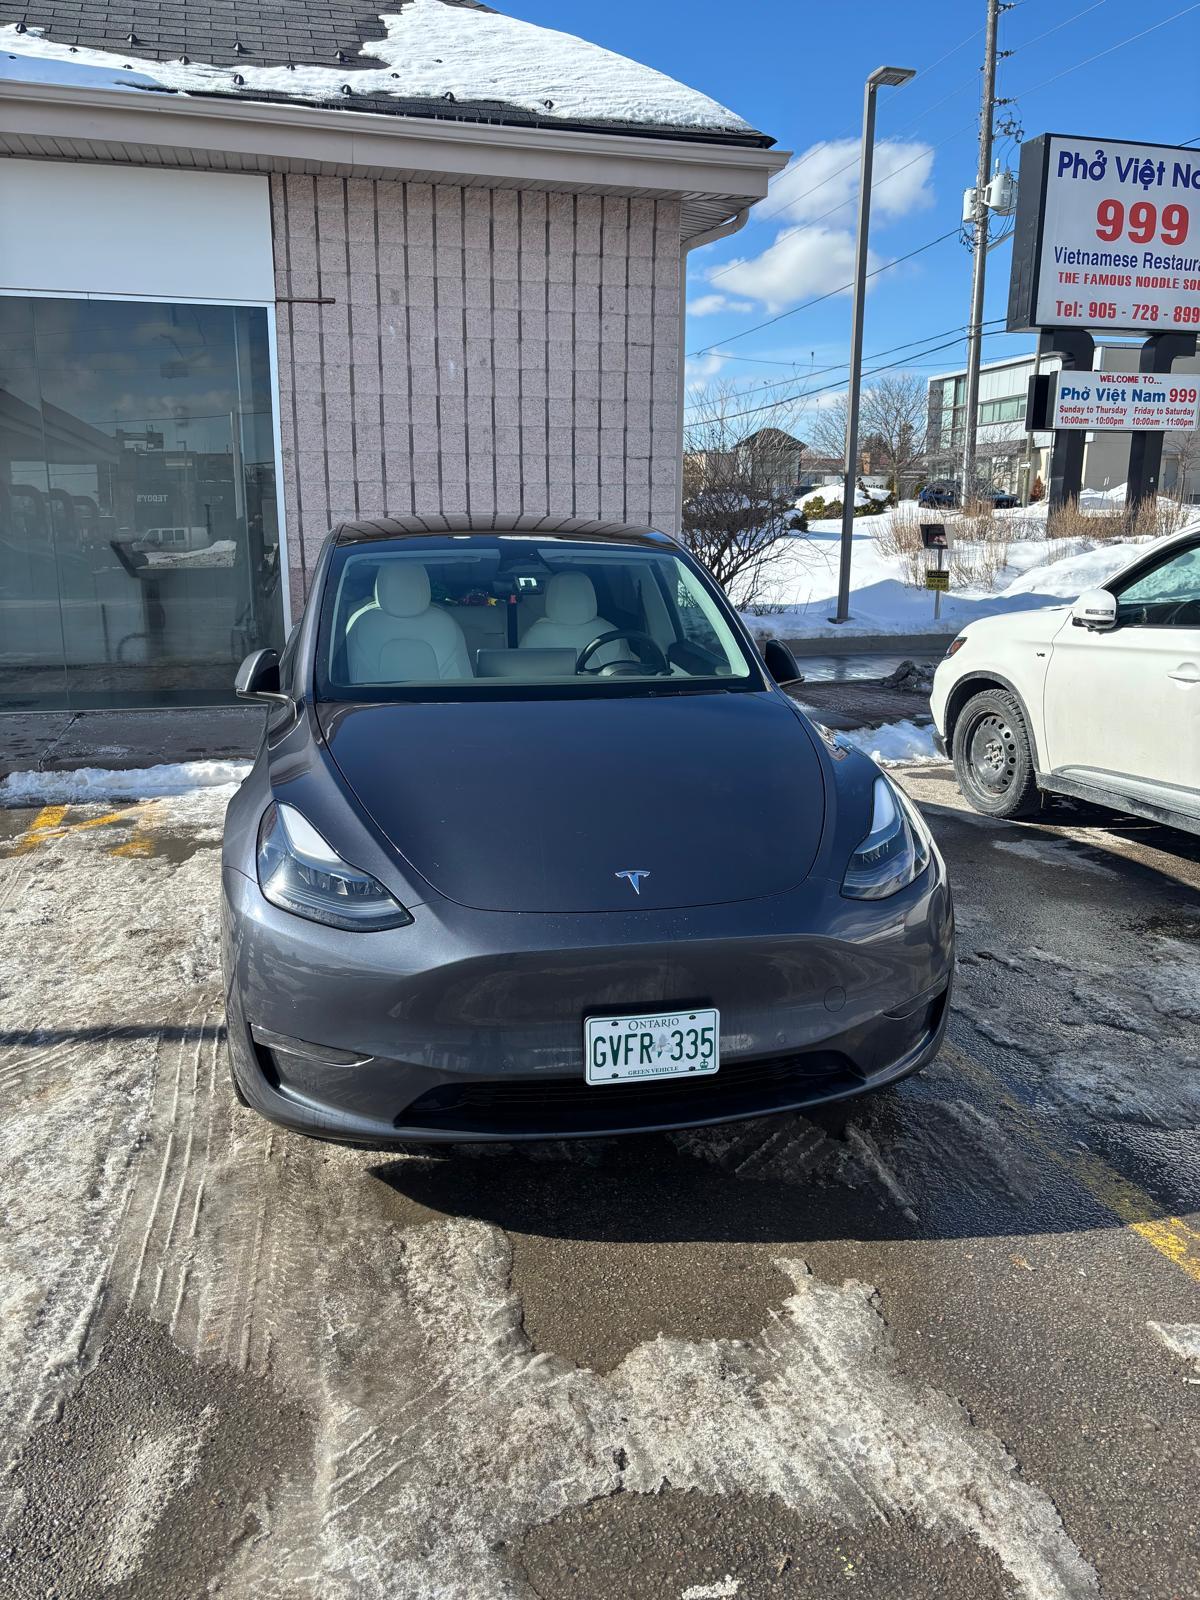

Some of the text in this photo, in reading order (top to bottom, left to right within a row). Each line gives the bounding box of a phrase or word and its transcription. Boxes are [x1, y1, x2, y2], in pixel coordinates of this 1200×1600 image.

[1057, 150, 1108, 182] Phở
[1115, 156, 1166, 191] Việt
[1096, 199, 1189, 246] 999
[1054, 246, 1138, 268] Vietnamese
[1058, 272, 1079, 284] THE
[1084, 273, 1132, 287] FAMOUS
[1135, 275, 1179, 289] NOODLE
[1056, 300, 1083, 318] Tel:
[1088, 301, 1117, 319] 905
[1132, 304, 1159, 321] 728
[1173, 305, 1200, 323] 899
[1100, 375, 1139, 384] WELCOME
[1060, 386, 1197, 405] Phở Việt Nam 999
[1059, 405, 1128, 415] Sunday to Thursday
[1134, 407, 1155, 416] Friday
[1165, 407, 1195, 417] Saturday
[1060, 416, 1089, 425] 10:00am
[1096, 417, 1124, 426] 10:00pm
[1132, 417, 1160, 426] 10:00am
[1166, 418, 1194, 427] 11:00pm
[593, 1027, 714, 1068] GVFR 335
[628, 1066, 679, 1076] GREEN VEHICLE
